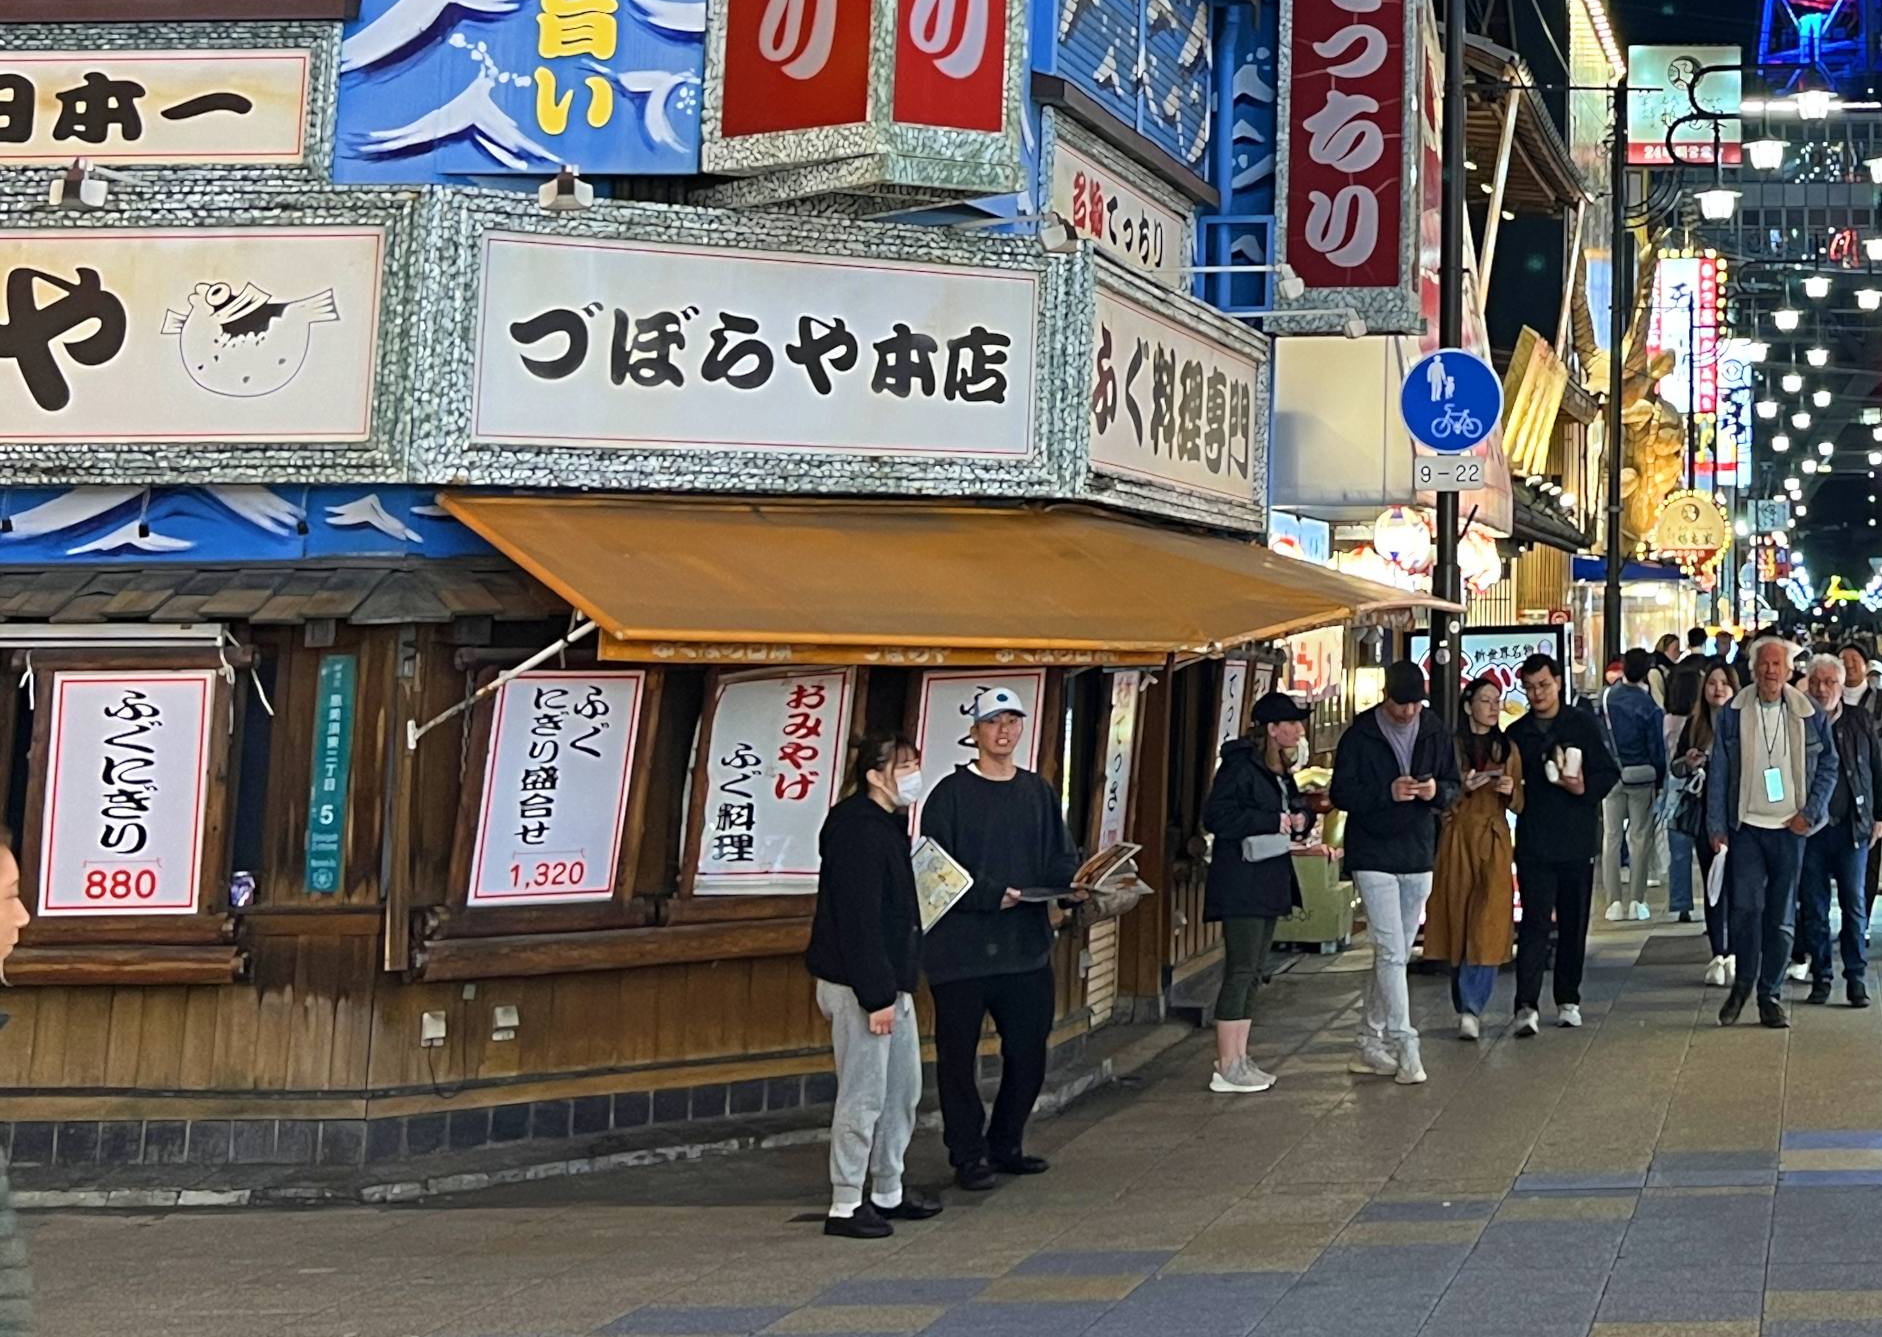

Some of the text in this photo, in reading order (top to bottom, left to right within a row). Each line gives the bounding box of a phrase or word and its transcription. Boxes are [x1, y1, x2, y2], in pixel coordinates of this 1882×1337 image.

[508, 301, 1013, 406] づぼらや本店
[514, 686, 570, 846] にぎり盛合せ
[569, 685, 611, 759] ふぐ
[773, 684, 826, 802] おみやげ
[712, 741, 763, 863] ふぐ料理
[85, 868, 157, 900] 880
[509, 860, 585, 890] 1,320
